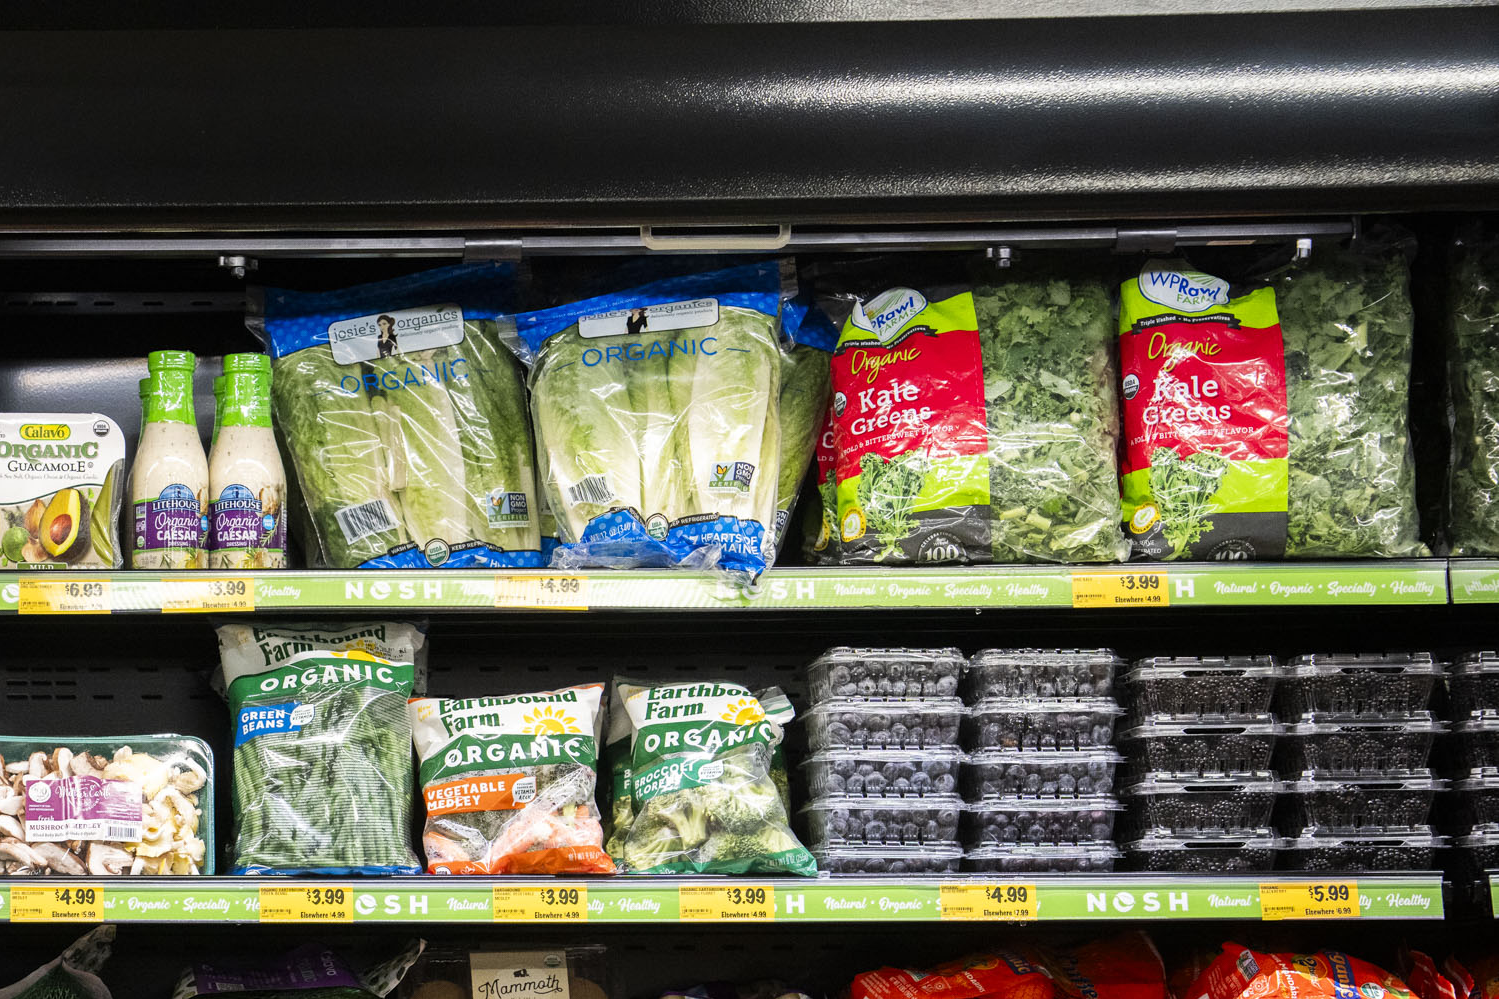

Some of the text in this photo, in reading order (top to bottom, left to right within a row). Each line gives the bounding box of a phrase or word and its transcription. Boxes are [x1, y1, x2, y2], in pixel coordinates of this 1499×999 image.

[334, 310, 458, 343] josie's organics
[582, 337, 718, 366] ORGANIC
[1148, 332, 1221, 372] Organic
[852, 348, 921, 384] Organic
[340, 358, 469, 394] ORGANIC
[858, 382, 920, 413] Kale
[24, 425, 66, 439] Calavo
[7, 460, 86, 472] GUACAMOLE
[152, 499, 200, 511] LITEHOUSE
[214, 499, 261, 511] LITEHOUSE
[157, 530, 197, 541] CAESAR
[217, 530, 257, 541] CAESAR
[701, 533, 756, 546] HEARTS OF
[345, 582, 442, 599] NOSH
[833, 580, 1049, 598] Natural Organic Specialty Healthy
[1120, 574, 1160, 592] $3.99
[259, 585, 301, 599] Healthy
[1115, 596, 1145, 604] Elsewhere
[260, 665, 394, 691] ORGANIC
[241, 710, 285, 722] GREEN
[645, 702, 703, 720] Farm
[242, 720, 284, 735] BEANS
[644, 722, 773, 753] ORGANIC
[445, 740, 581, 768] ORGANIC
[427, 781, 505, 799] VEGETABLE
[427, 795, 480, 810] MEDLEY
[55, 889, 95, 905] $4.99
[307, 888, 344, 905] $3.99
[540, 888, 579, 905] $3.99
[727, 888, 766, 904] $3.99
[986, 887, 1028, 903] $4.99
[1309, 885, 1349, 902] $5.99
[1385, 894, 1430, 908] Healthy
[128, 897, 230, 913] Organic Specialty
[824, 897, 922, 911] Natural Organic
[1086, 892, 1189, 913] NOSH
